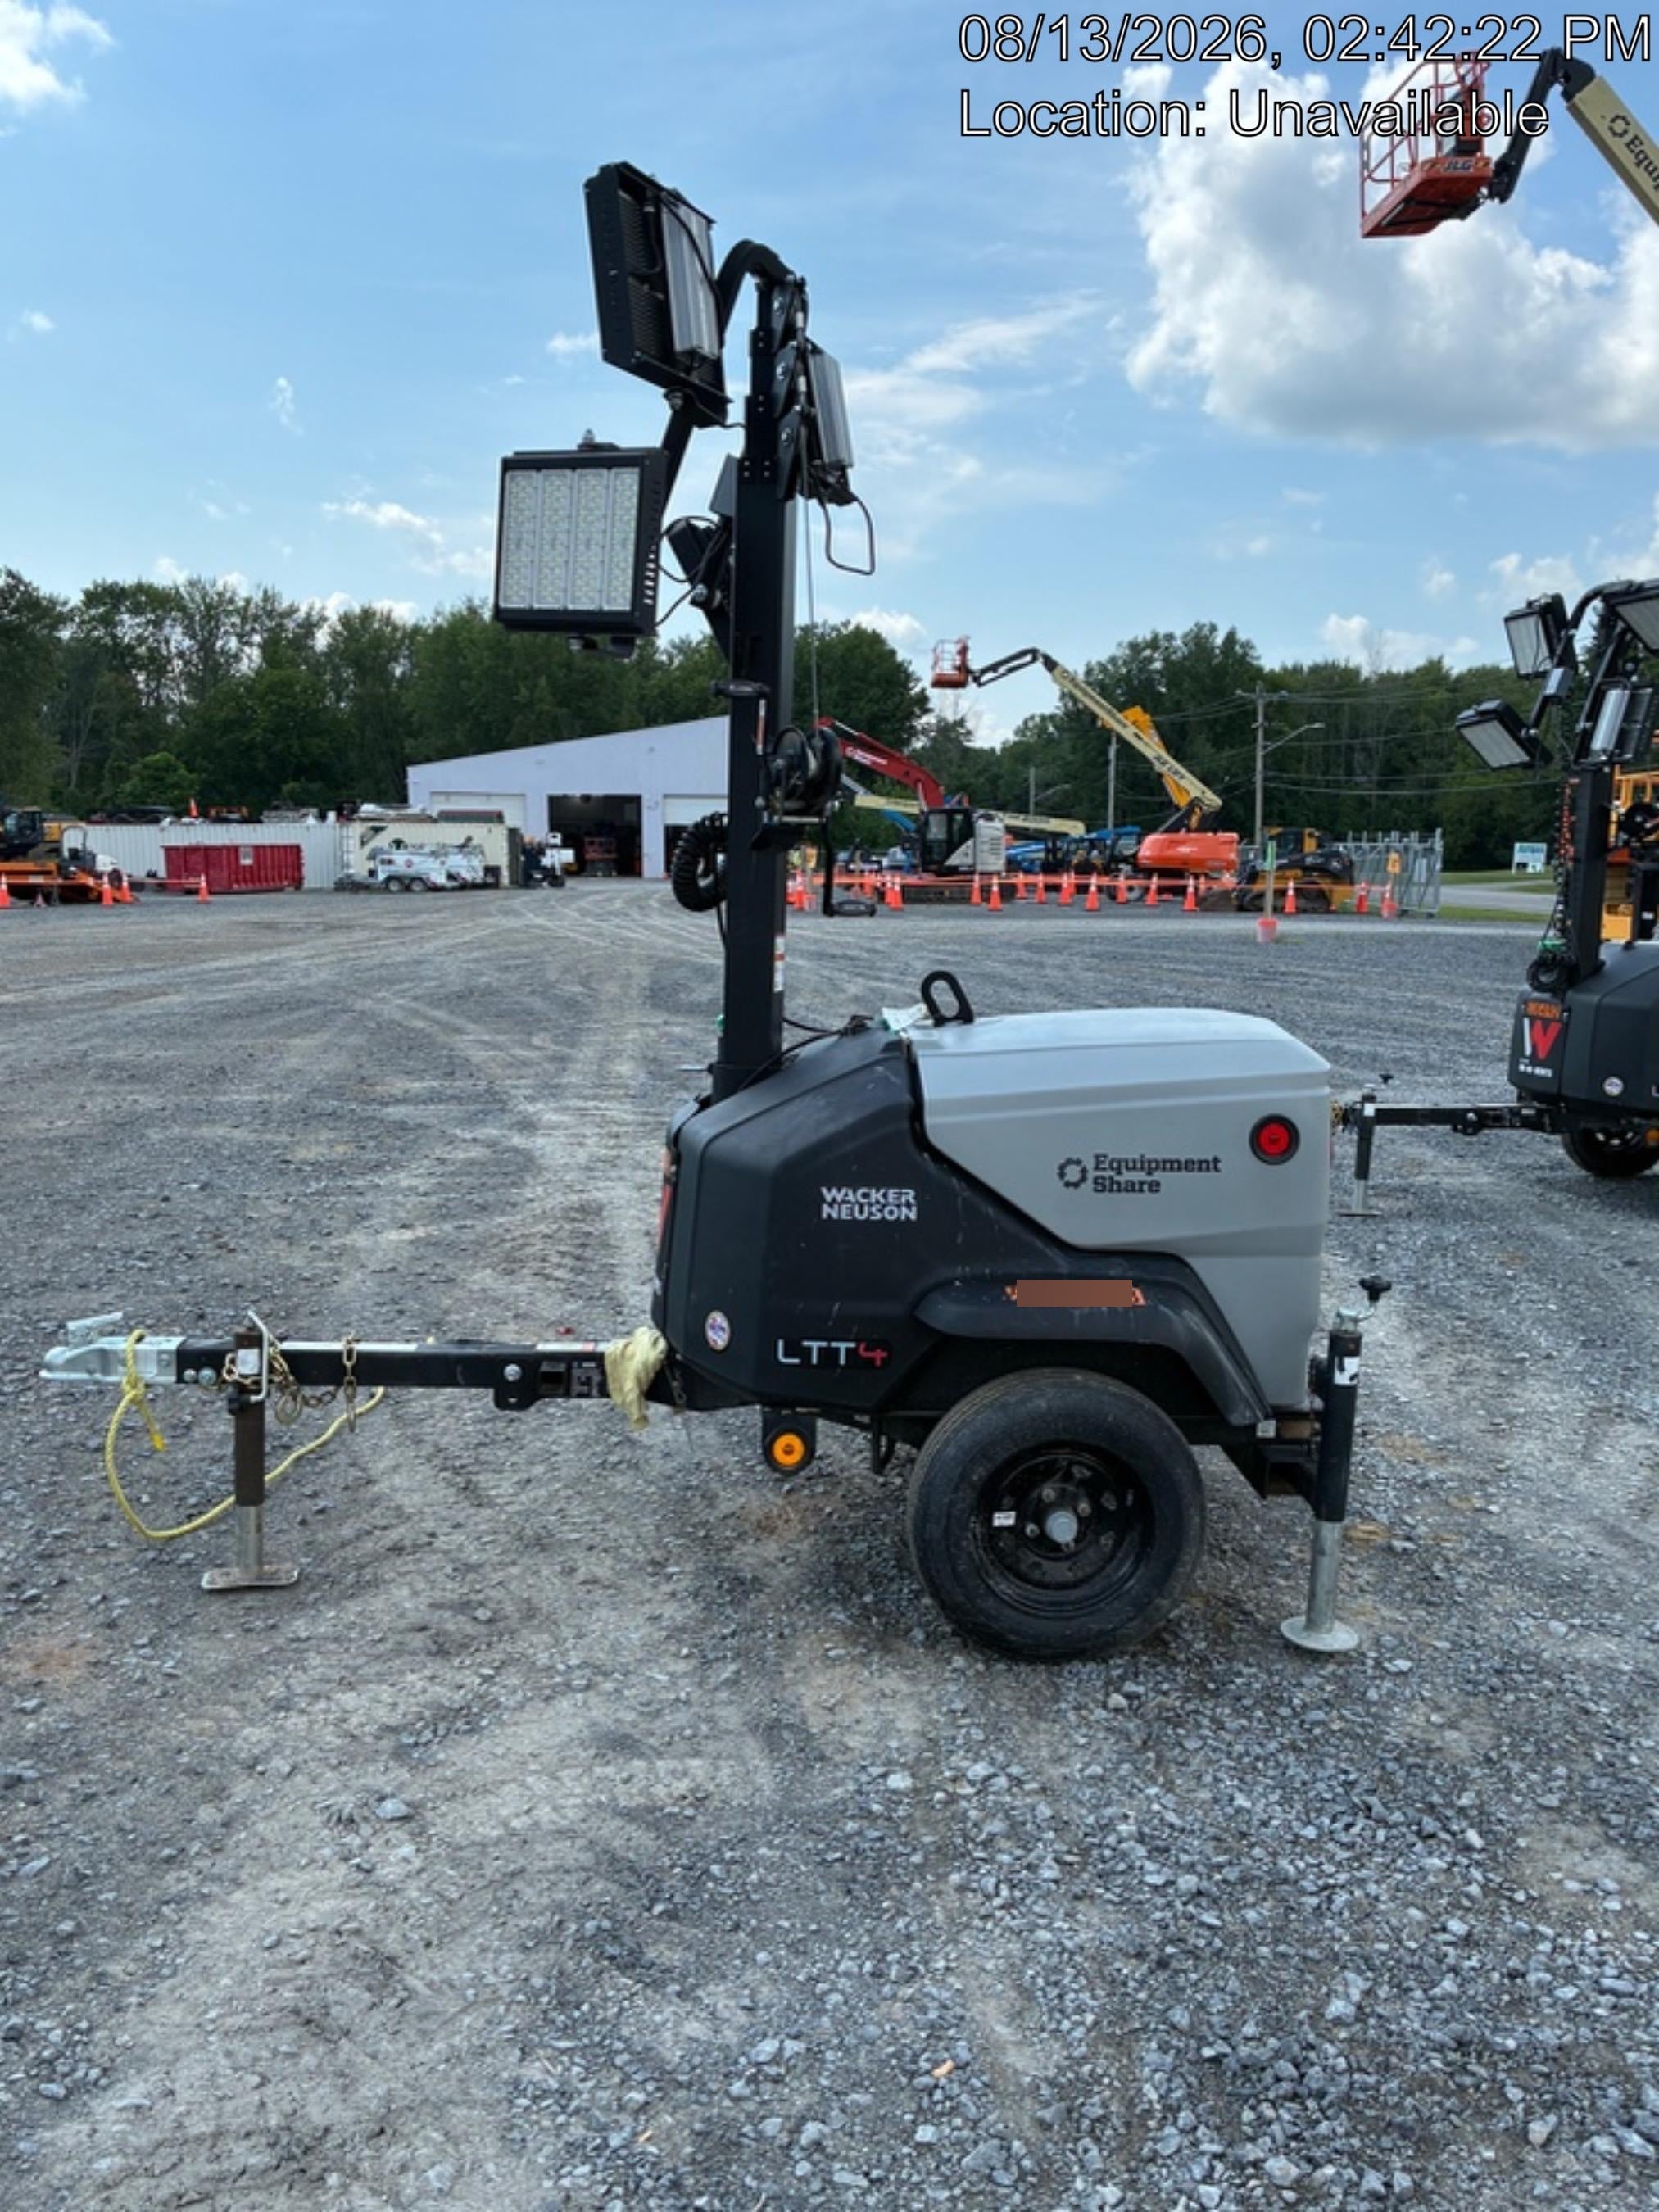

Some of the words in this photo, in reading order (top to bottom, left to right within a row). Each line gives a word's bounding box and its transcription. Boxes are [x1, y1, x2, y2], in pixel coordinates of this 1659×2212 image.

[1093, 1154, 1222, 1176] Equipment
[1093, 1175, 1162, 1193] Share
[821, 1186, 916, 1204] WACKER
[822, 1203, 917, 1220] NEUSON
[777, 1339, 888, 1367] LTT4
